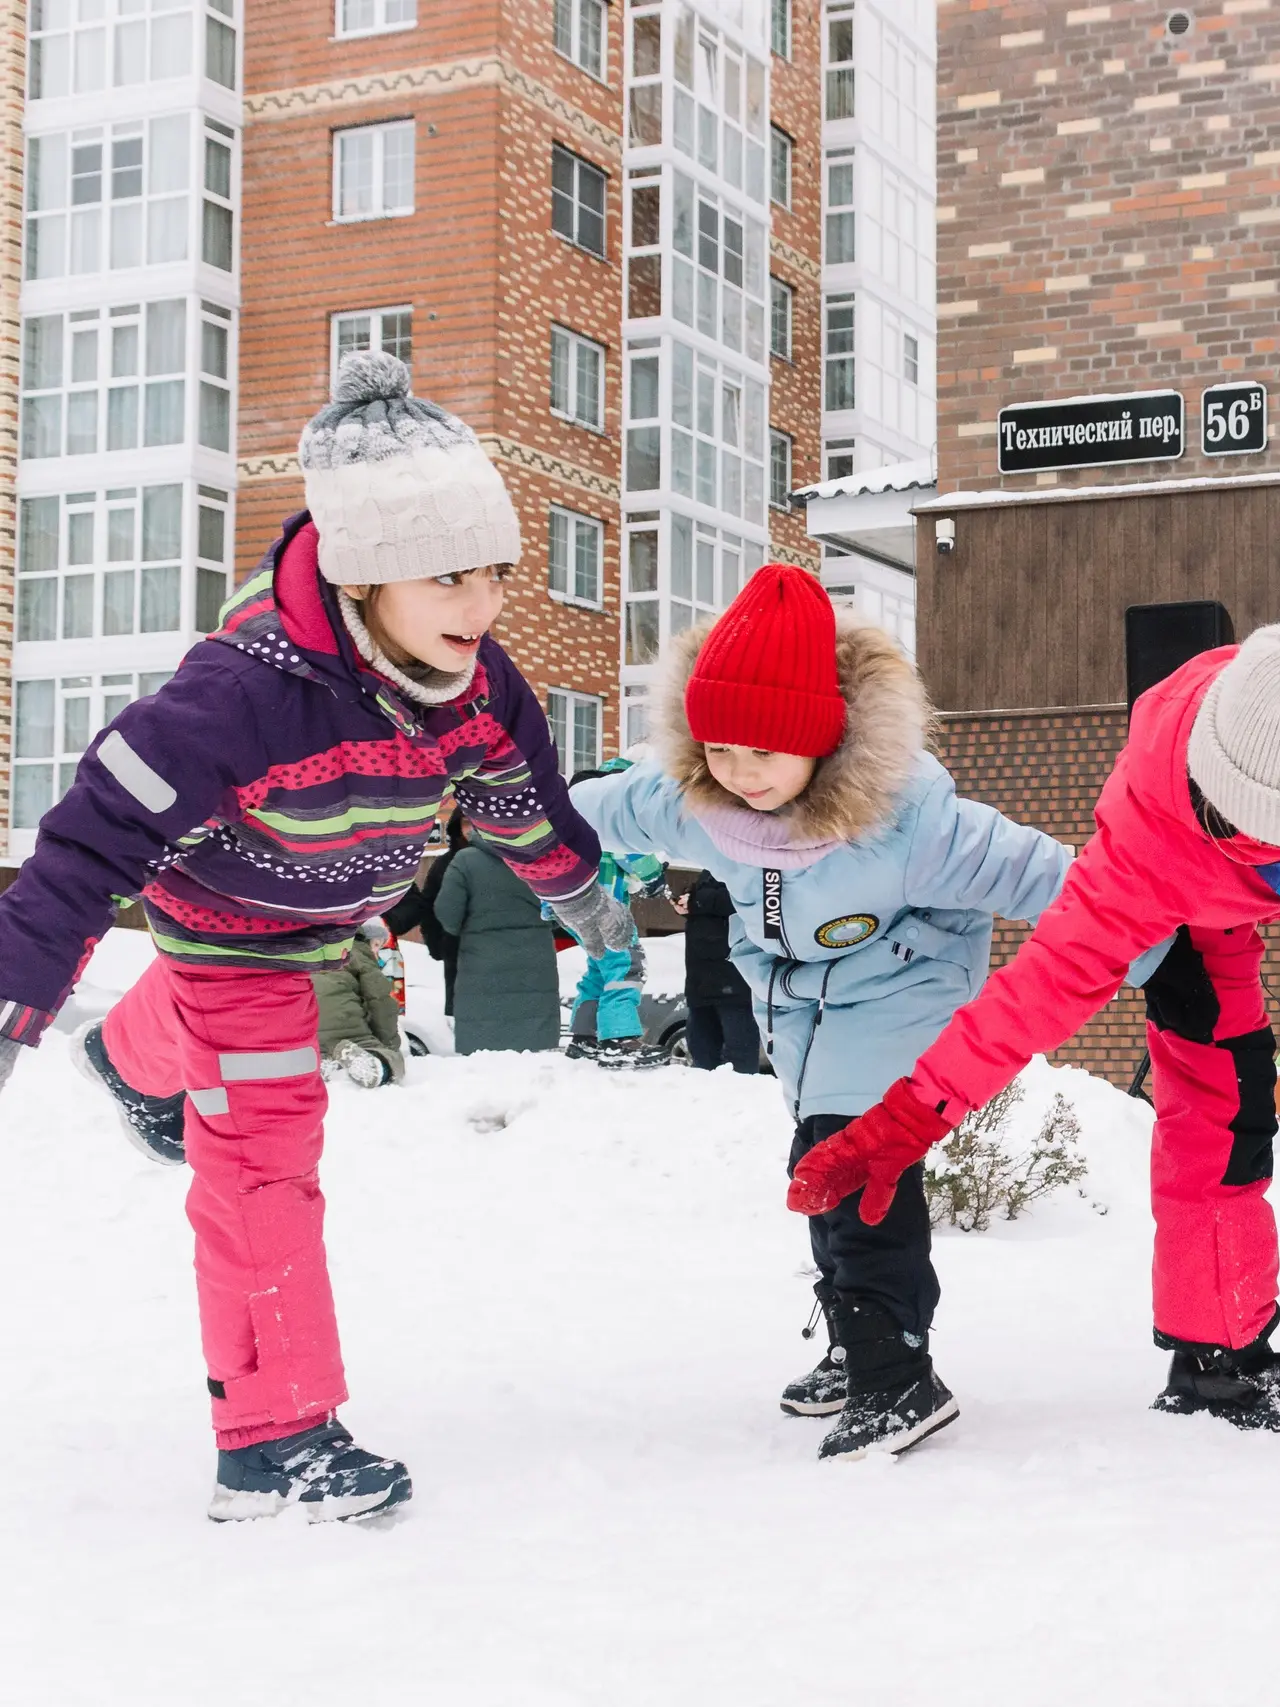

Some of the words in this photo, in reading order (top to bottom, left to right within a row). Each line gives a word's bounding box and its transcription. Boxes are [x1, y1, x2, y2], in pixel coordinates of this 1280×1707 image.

[1002, 411, 1133, 450] Технический
[1139, 413, 1180, 443] пер.
[765, 871, 781, 927] SNOW
